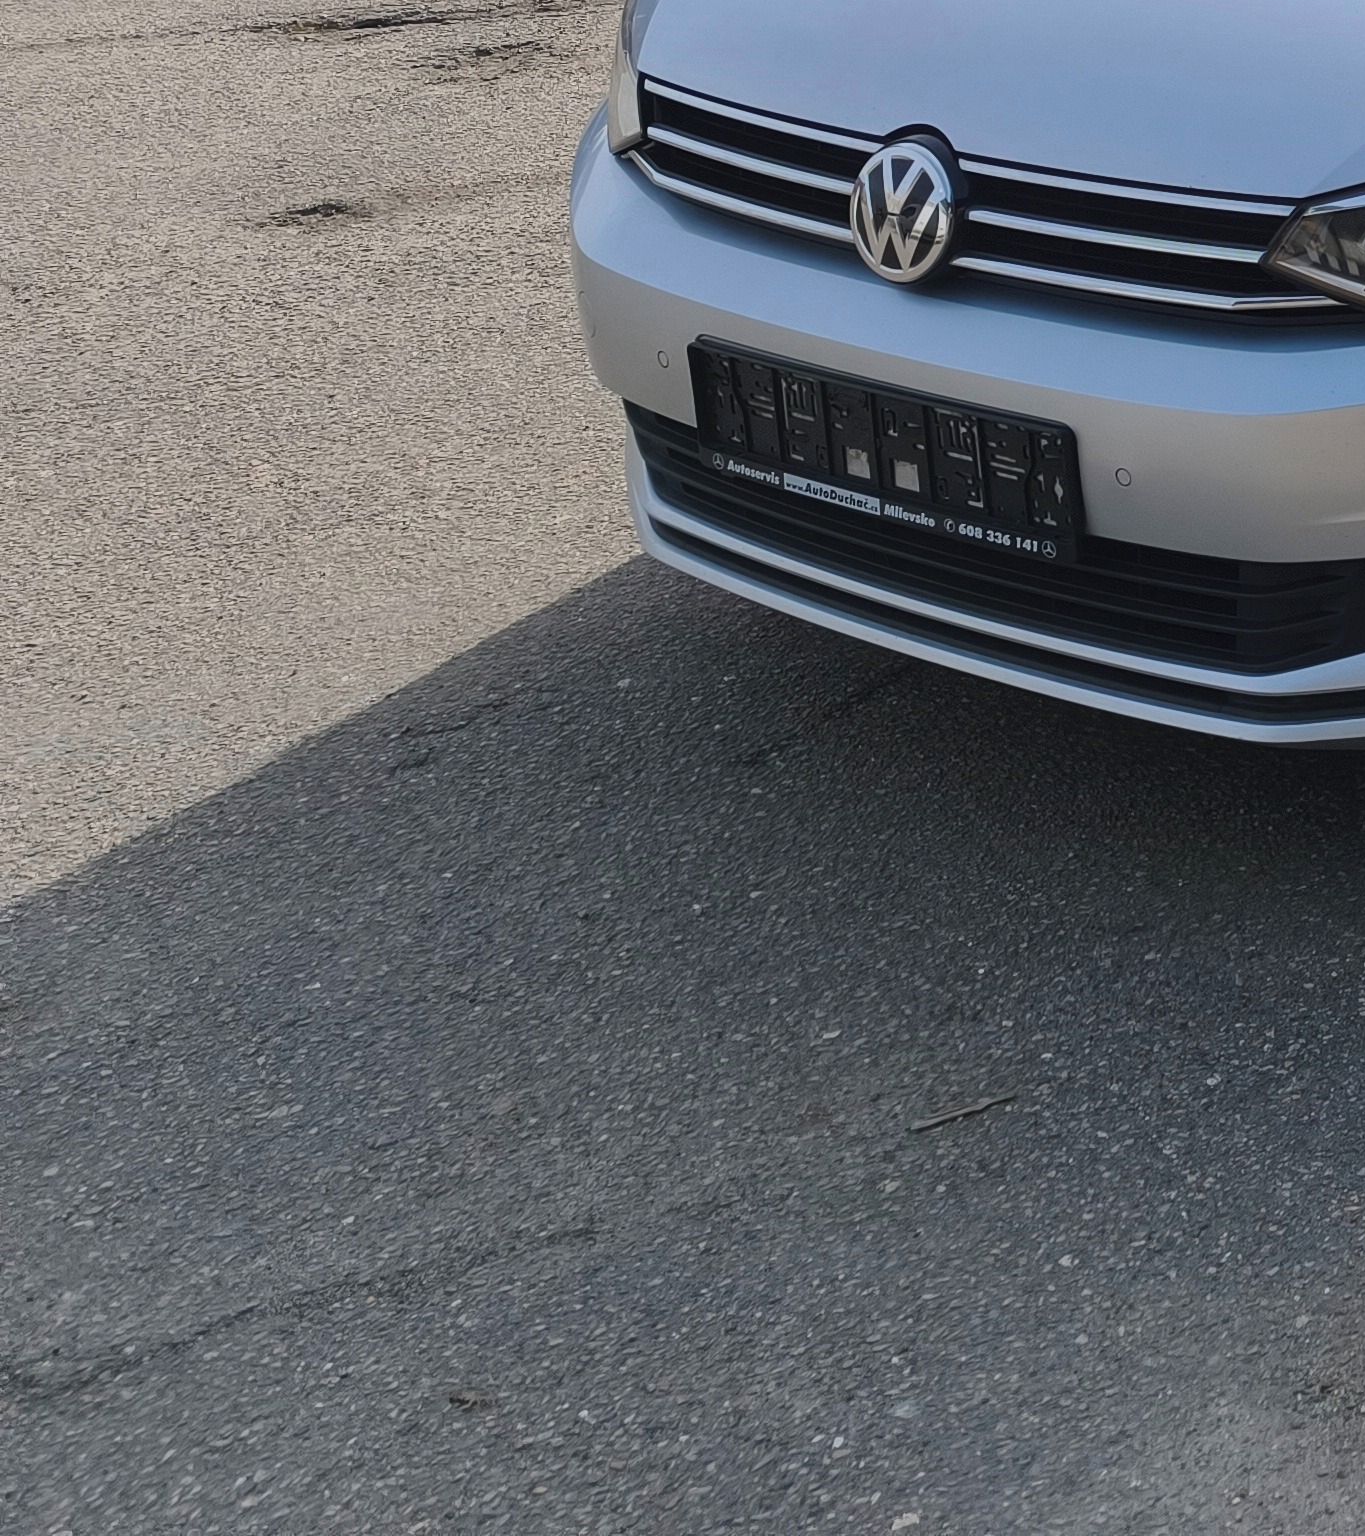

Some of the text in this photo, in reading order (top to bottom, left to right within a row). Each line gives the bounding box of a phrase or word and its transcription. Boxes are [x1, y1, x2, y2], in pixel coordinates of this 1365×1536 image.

[856, 148, 949, 276] VW
[727, 459, 780, 485] Autoservis
[884, 503, 935, 527] Milevsko
[958, 523, 983, 539] 608
[986, 529, 1011, 546] 336
[1015, 536, 1038, 552] 141
